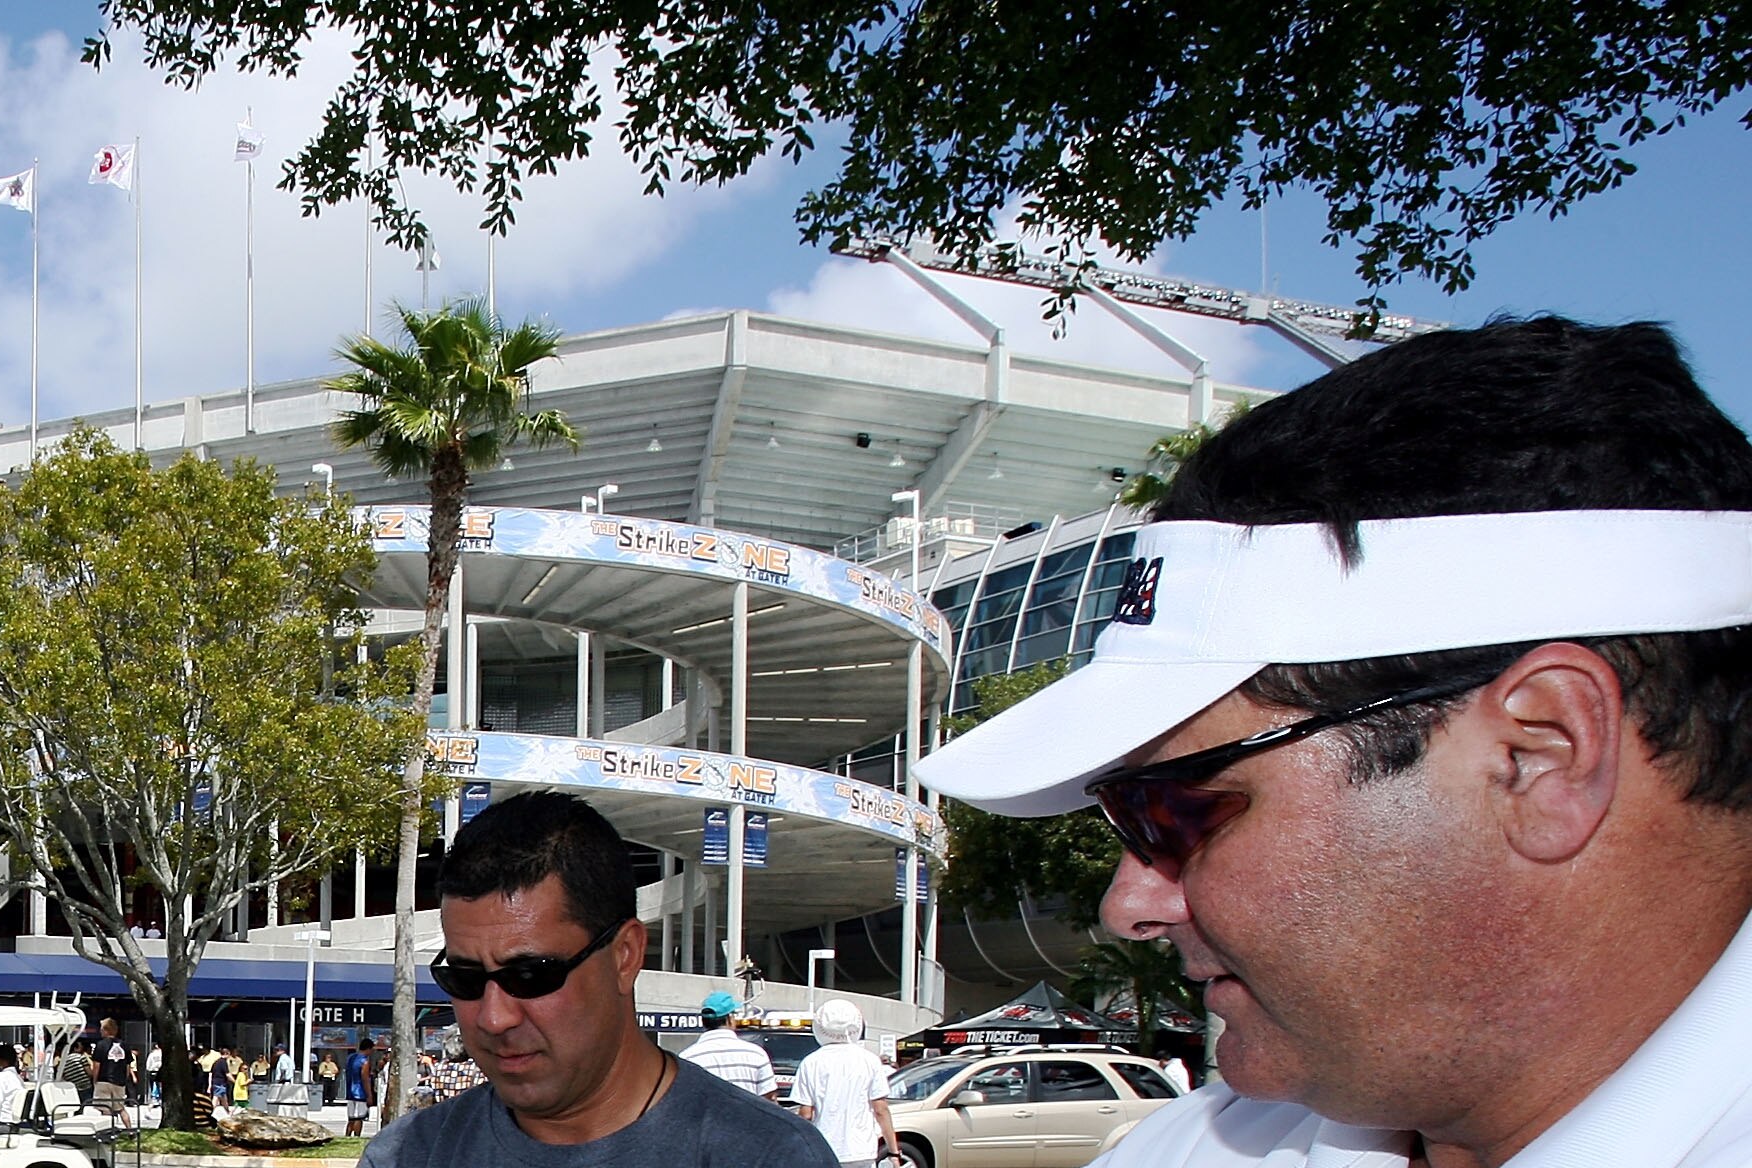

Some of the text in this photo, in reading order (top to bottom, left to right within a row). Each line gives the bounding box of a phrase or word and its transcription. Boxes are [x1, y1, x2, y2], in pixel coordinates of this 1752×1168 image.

[591, 520, 617, 536] THE
[618, 525, 690, 556] Strike
[575, 745, 601, 760] THE
[602, 750, 675, 780] Strike
[744, 791, 767, 804] GATE
[353, 1007, 365, 1023] H
